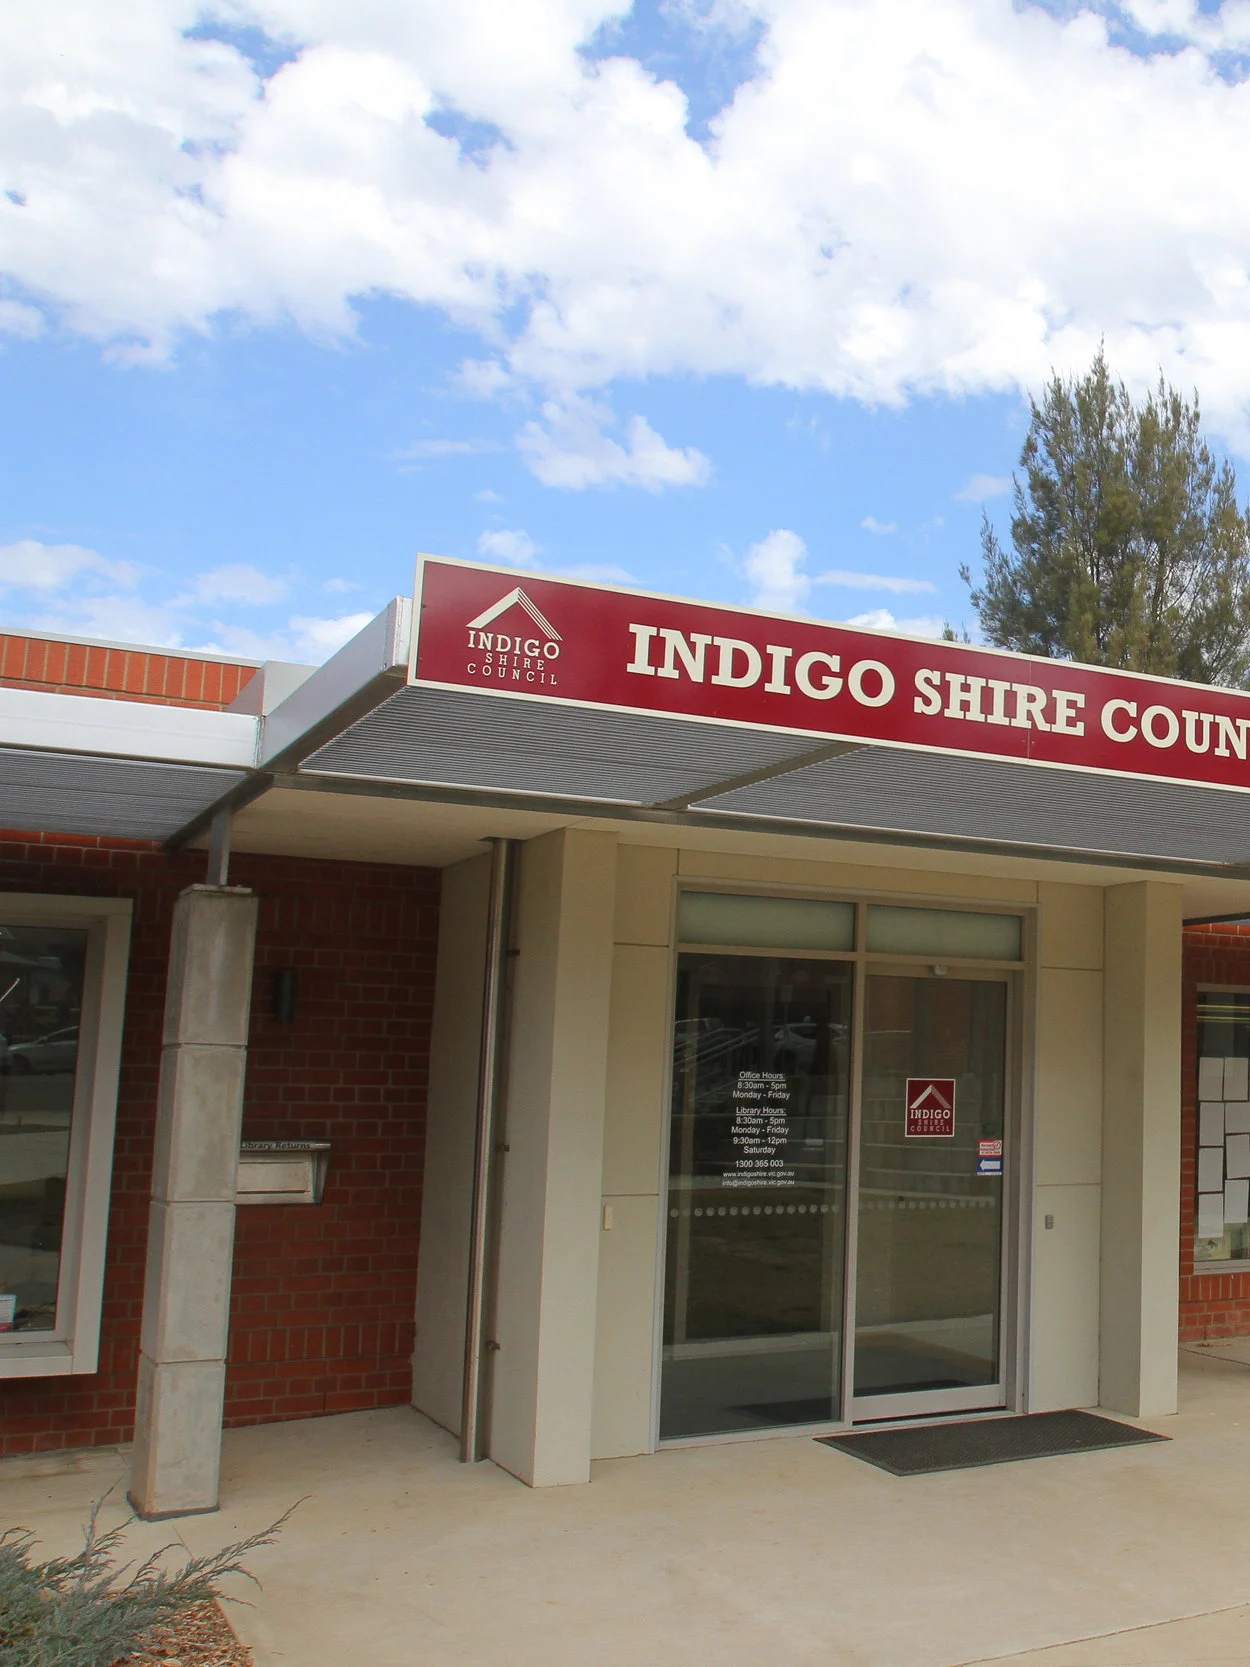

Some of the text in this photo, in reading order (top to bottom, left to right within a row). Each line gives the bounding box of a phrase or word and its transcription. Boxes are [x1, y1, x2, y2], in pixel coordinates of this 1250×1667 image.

[467, 630, 560, 660] INDIGO
[485, 652, 545, 671] SHIRE
[467, 663, 558, 685] COUNCIL
[626, 623, 895, 708] INDIGO
[914, 668, 1086, 737] SHIRE
[739, 1071, 761, 1080] Office
[737, 1081, 765, 1089] 8:30am
[771, 1081, 787, 1091] 5pm
[732, 1090, 762, 1100] Monday
[767, 1090, 791, 1100] Friday
[736, 1106, 787, 1116] Library Hours:
[910, 1109, 951, 1119] INDIGO
[736, 1116, 764, 1125] 8:30am
[769, 1116, 786, 1126] 5pm
[731, 1125, 761, 1135] Monday
[766, 1125, 790, 1135] Friday
[240, 1141, 311, 1150] Library Returns
[733, 1136, 761, 1145] 9:30am
[767, 1136, 787, 1146] 12pm
[743, 1145, 776, 1155] Saturday
[735, 1159, 784, 1168] 1300 365 003
